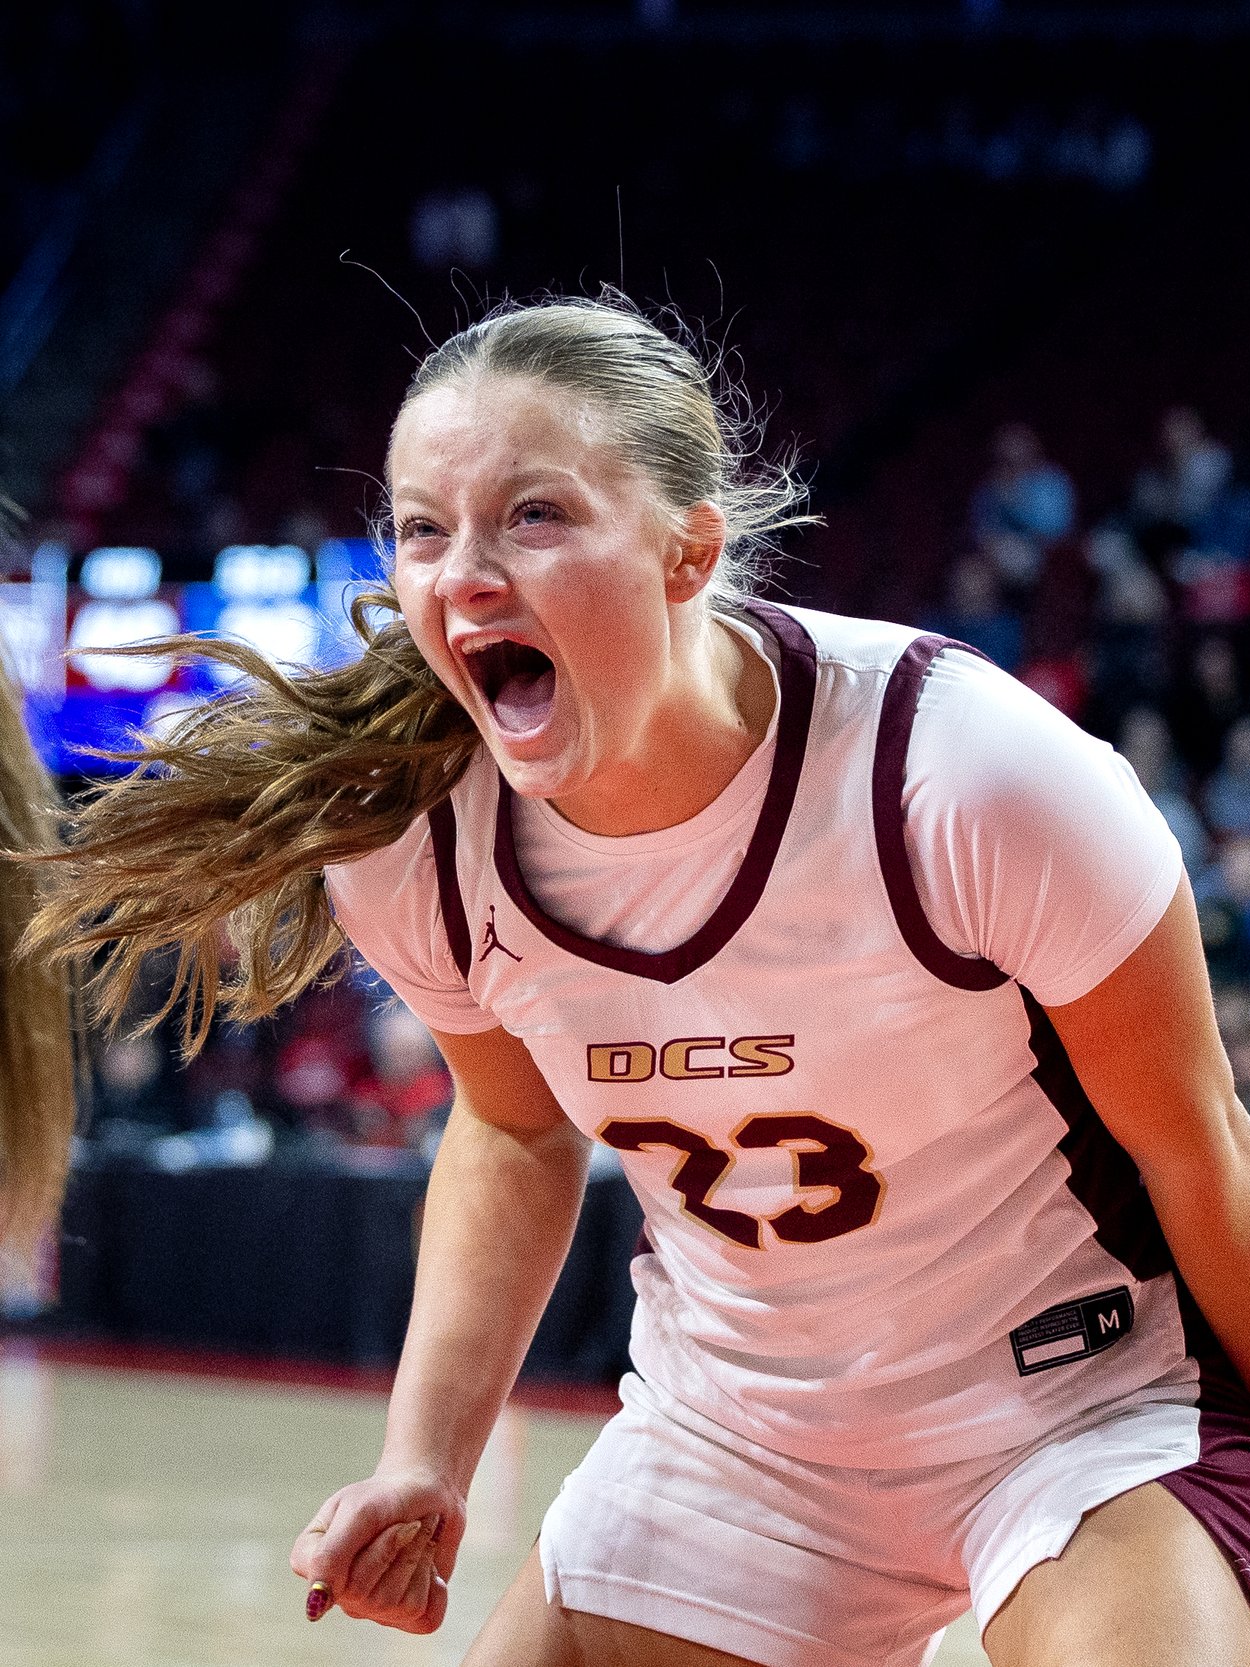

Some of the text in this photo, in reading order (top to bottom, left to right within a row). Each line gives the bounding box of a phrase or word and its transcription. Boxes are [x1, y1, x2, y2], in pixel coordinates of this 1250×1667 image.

[587, 1034, 795, 1083] DCS
[594, 1110, 889, 1251] 23
[1097, 1309, 1120, 1334] M
